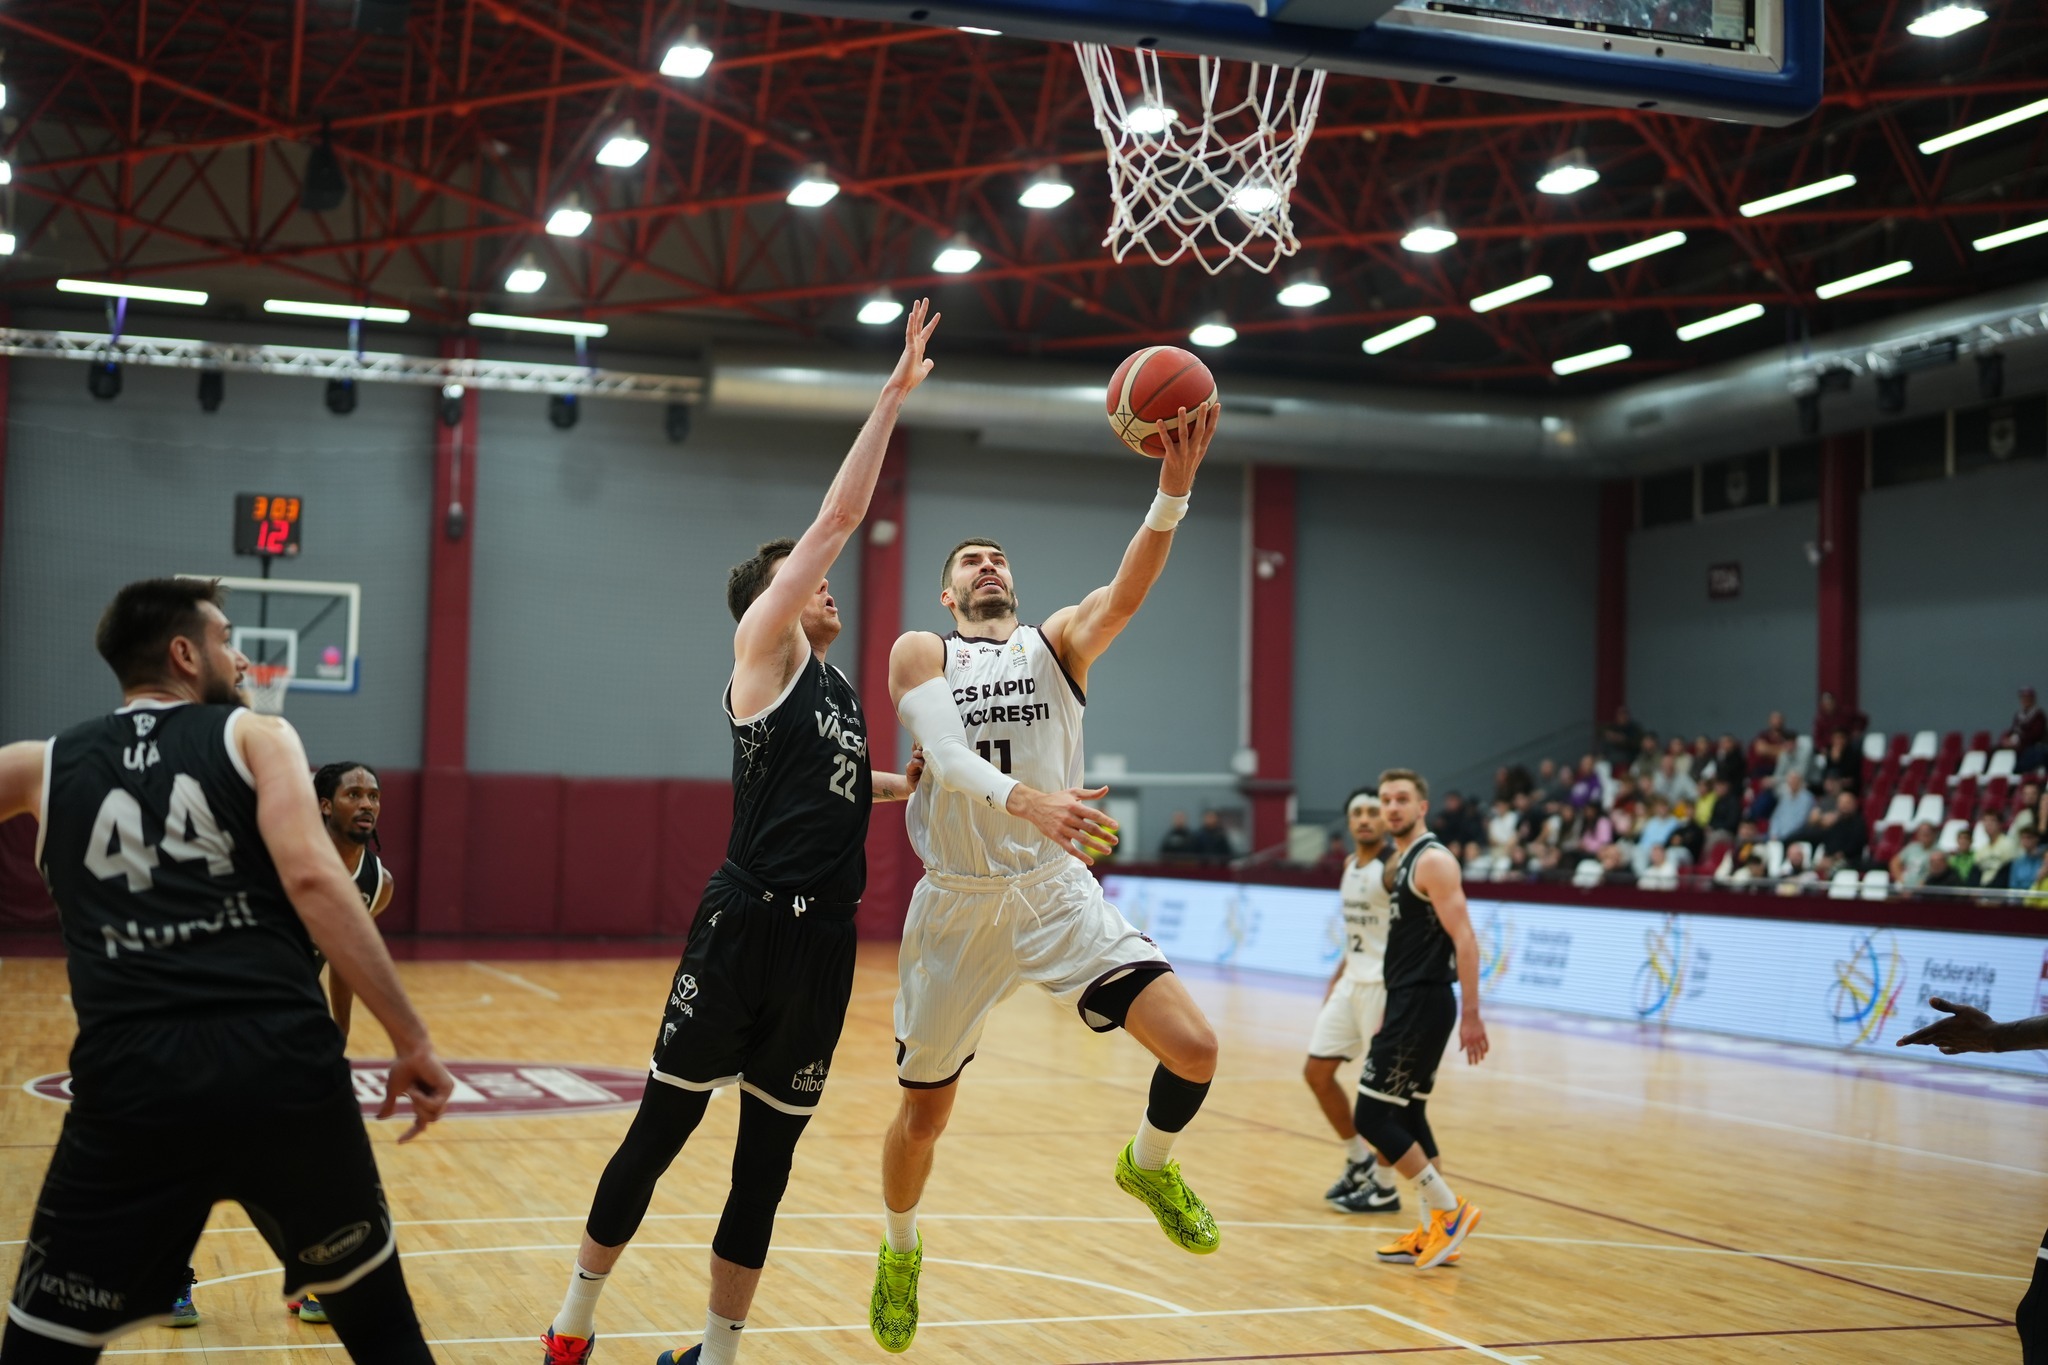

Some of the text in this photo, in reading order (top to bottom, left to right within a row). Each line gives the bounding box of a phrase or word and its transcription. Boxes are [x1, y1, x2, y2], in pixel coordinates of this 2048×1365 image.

[257, 520, 289, 554] 12
[952, 677, 1036, 706] CS RAPID
[976, 739, 1012, 775] 11
[829, 753, 857, 803] 22
[83, 773, 236, 894] 44
[670, 992, 694, 1018] TOYOTA
